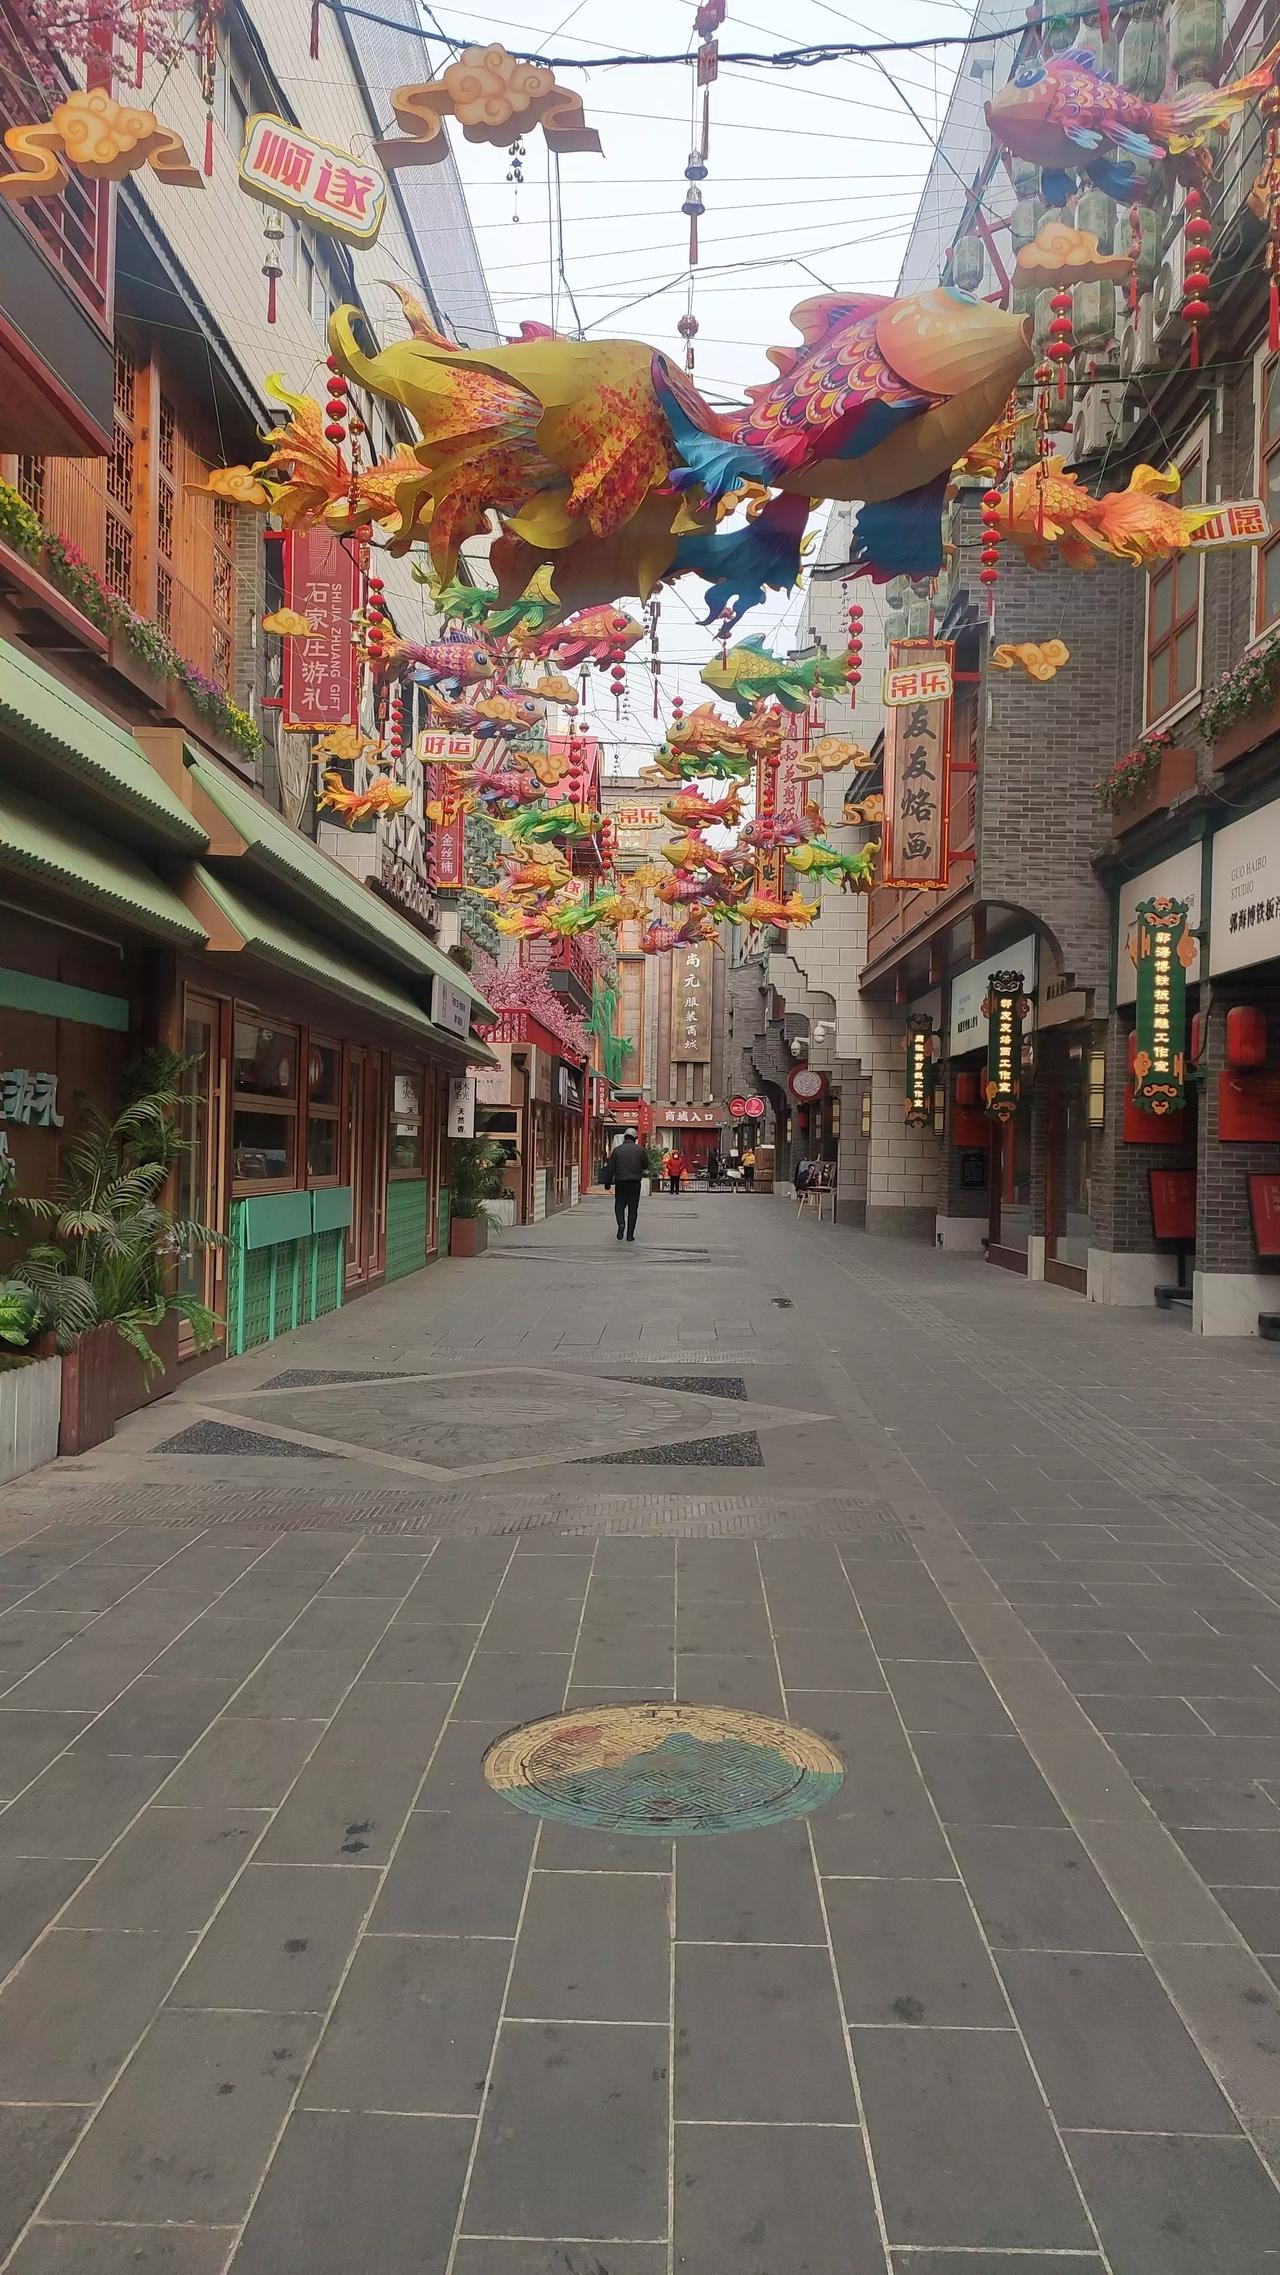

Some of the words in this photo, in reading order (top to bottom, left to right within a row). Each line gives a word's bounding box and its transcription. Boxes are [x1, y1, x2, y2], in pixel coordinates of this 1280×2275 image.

[253, 130, 375, 221] 顺遂
[301, 582, 330, 711] 石家庄游礼
[330, 628, 341, 678] ZHUANG
[329, 684, 340, 711] GIFT
[891, 668, 945, 698] 常乐
[424, 736, 471, 756] 好运
[901, 703, 937, 861] 友友烙画
[440, 833, 454, 875] 金丝楠
[1231, 865, 1245, 881] GUO
[1231, 880, 1255, 900] STUDIO
[684, 942, 701, 1050] 尚元服装商城
[0, 1068, 64, 1127] 游礼
[665, 1110, 713, 1123] 商城入口
